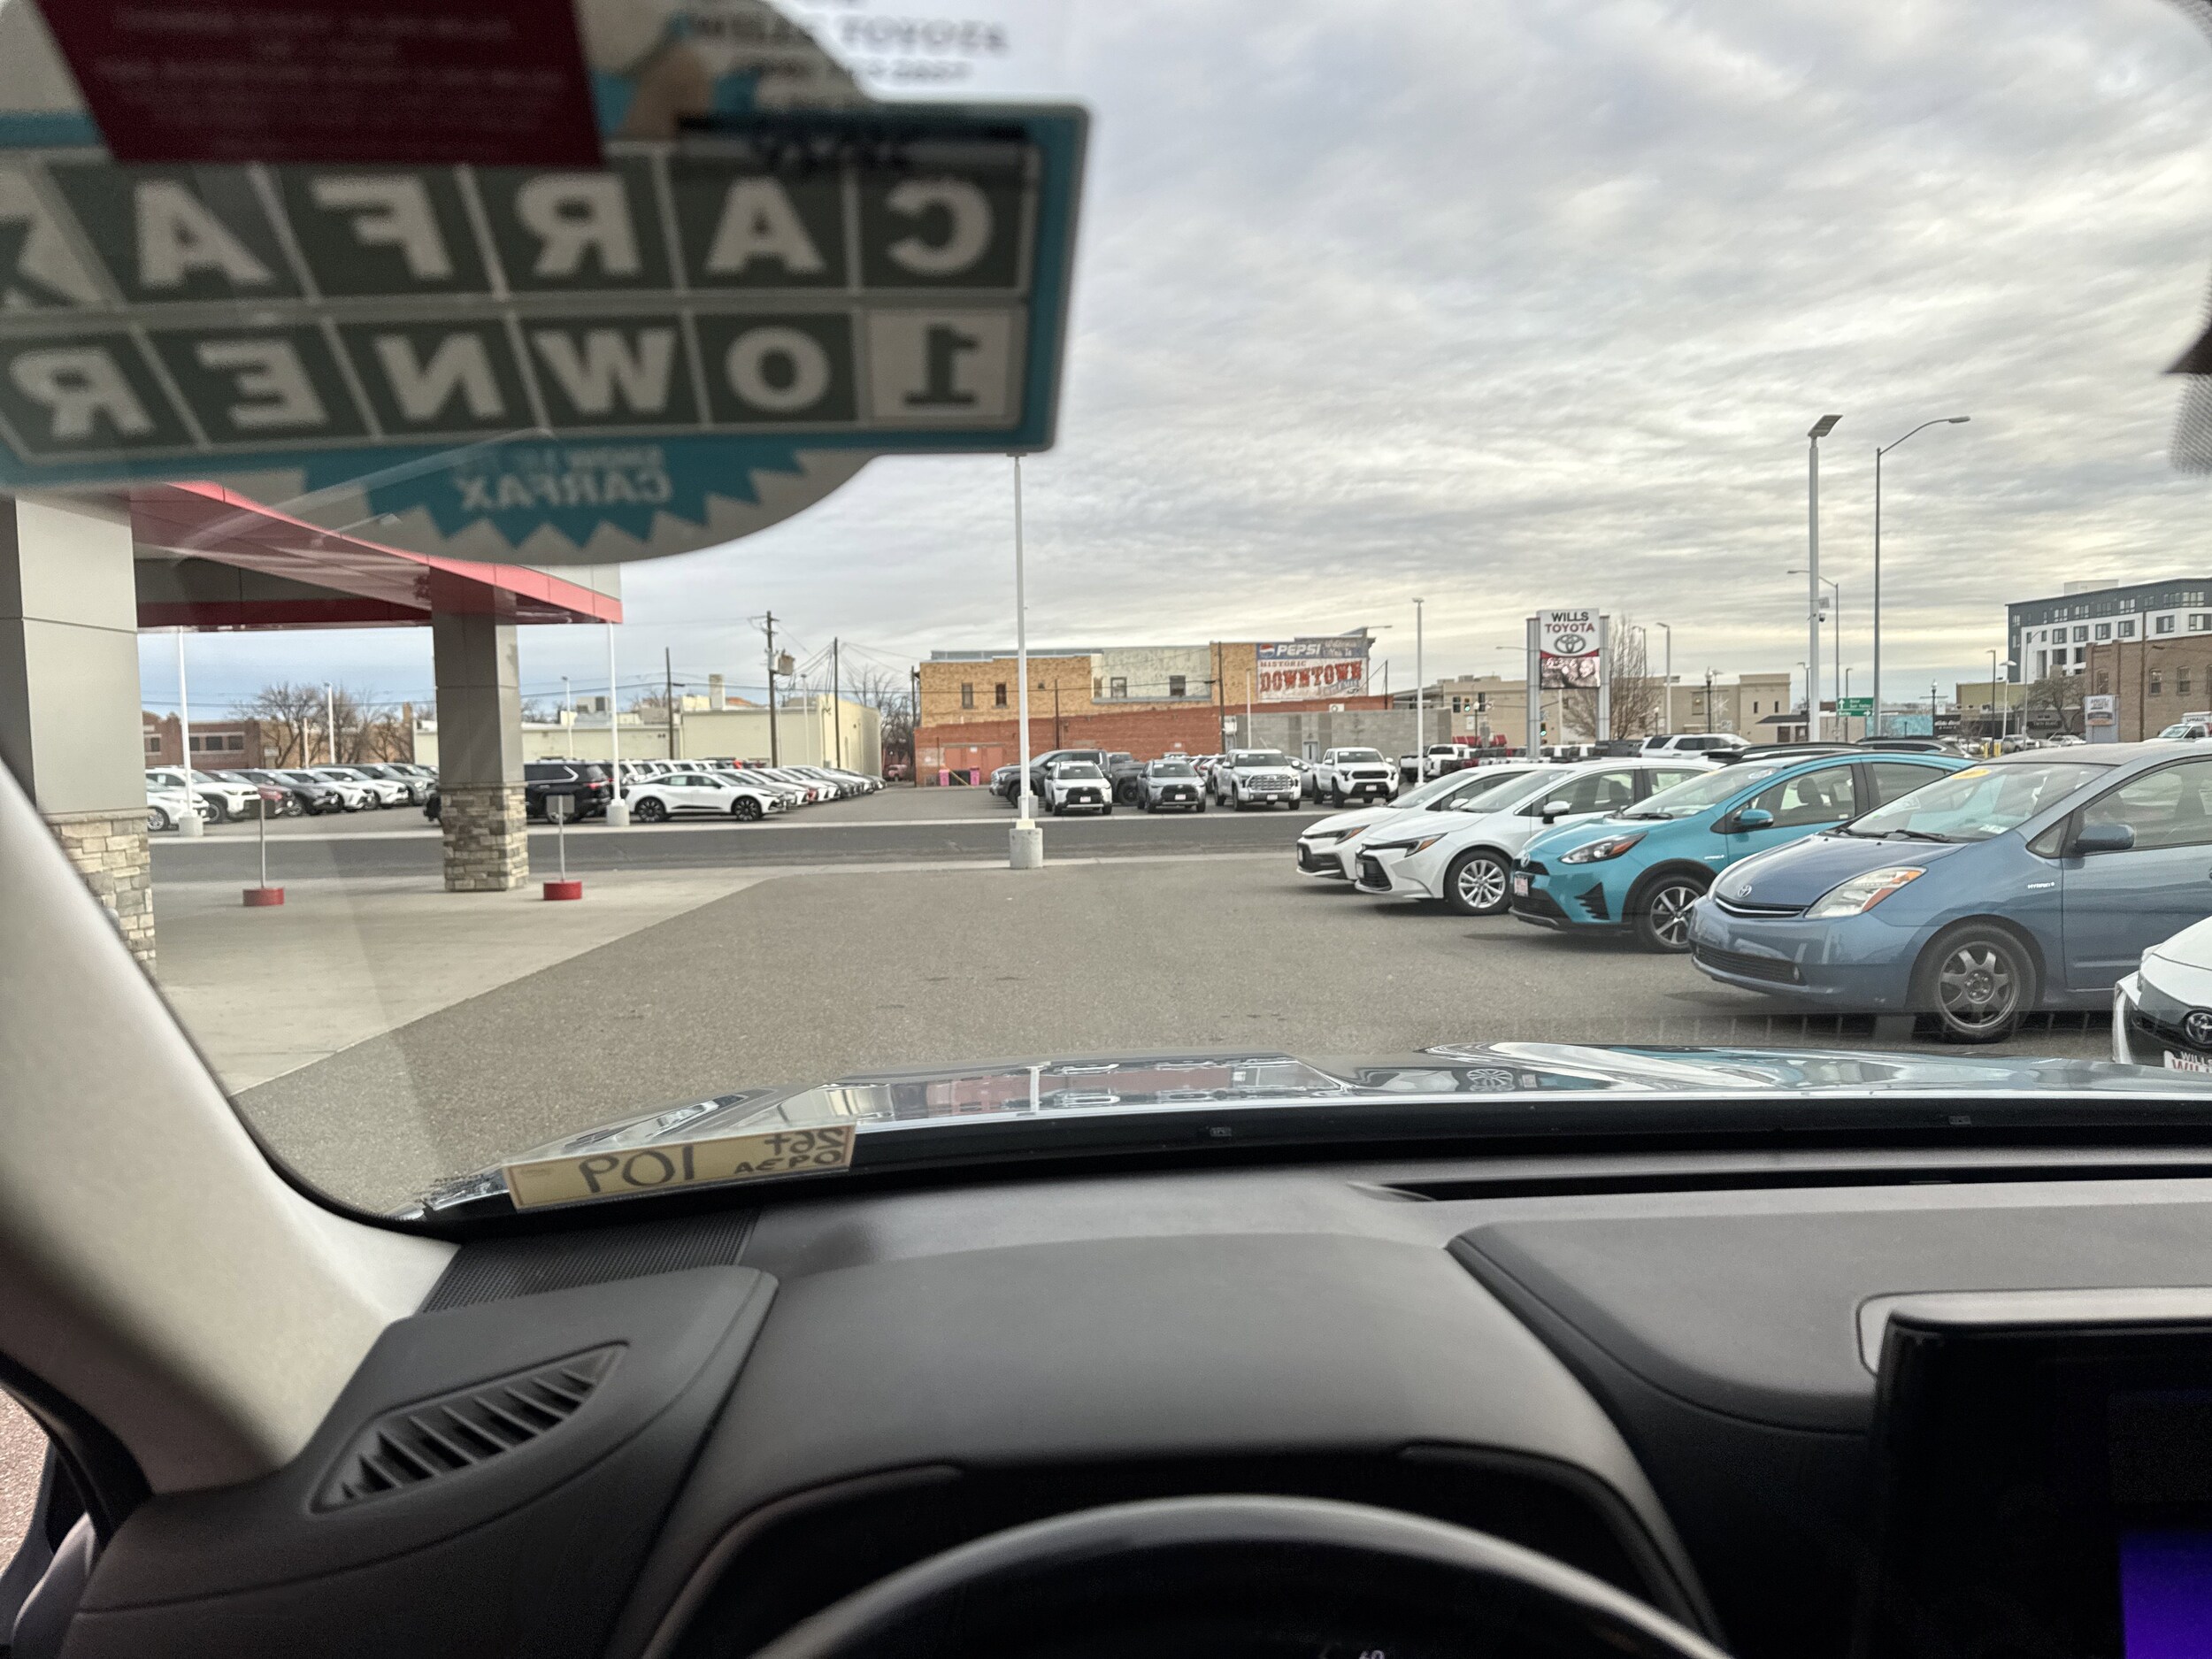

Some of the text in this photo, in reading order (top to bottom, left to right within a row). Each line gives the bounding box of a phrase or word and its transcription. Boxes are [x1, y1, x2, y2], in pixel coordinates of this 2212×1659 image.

[1551, 611, 1589, 622] WILLS
[1544, 623, 1595, 634] TOYOTA
[1276, 644, 1320, 657] PEPSI
[1259, 660, 1363, 693] DOWNTOWN
